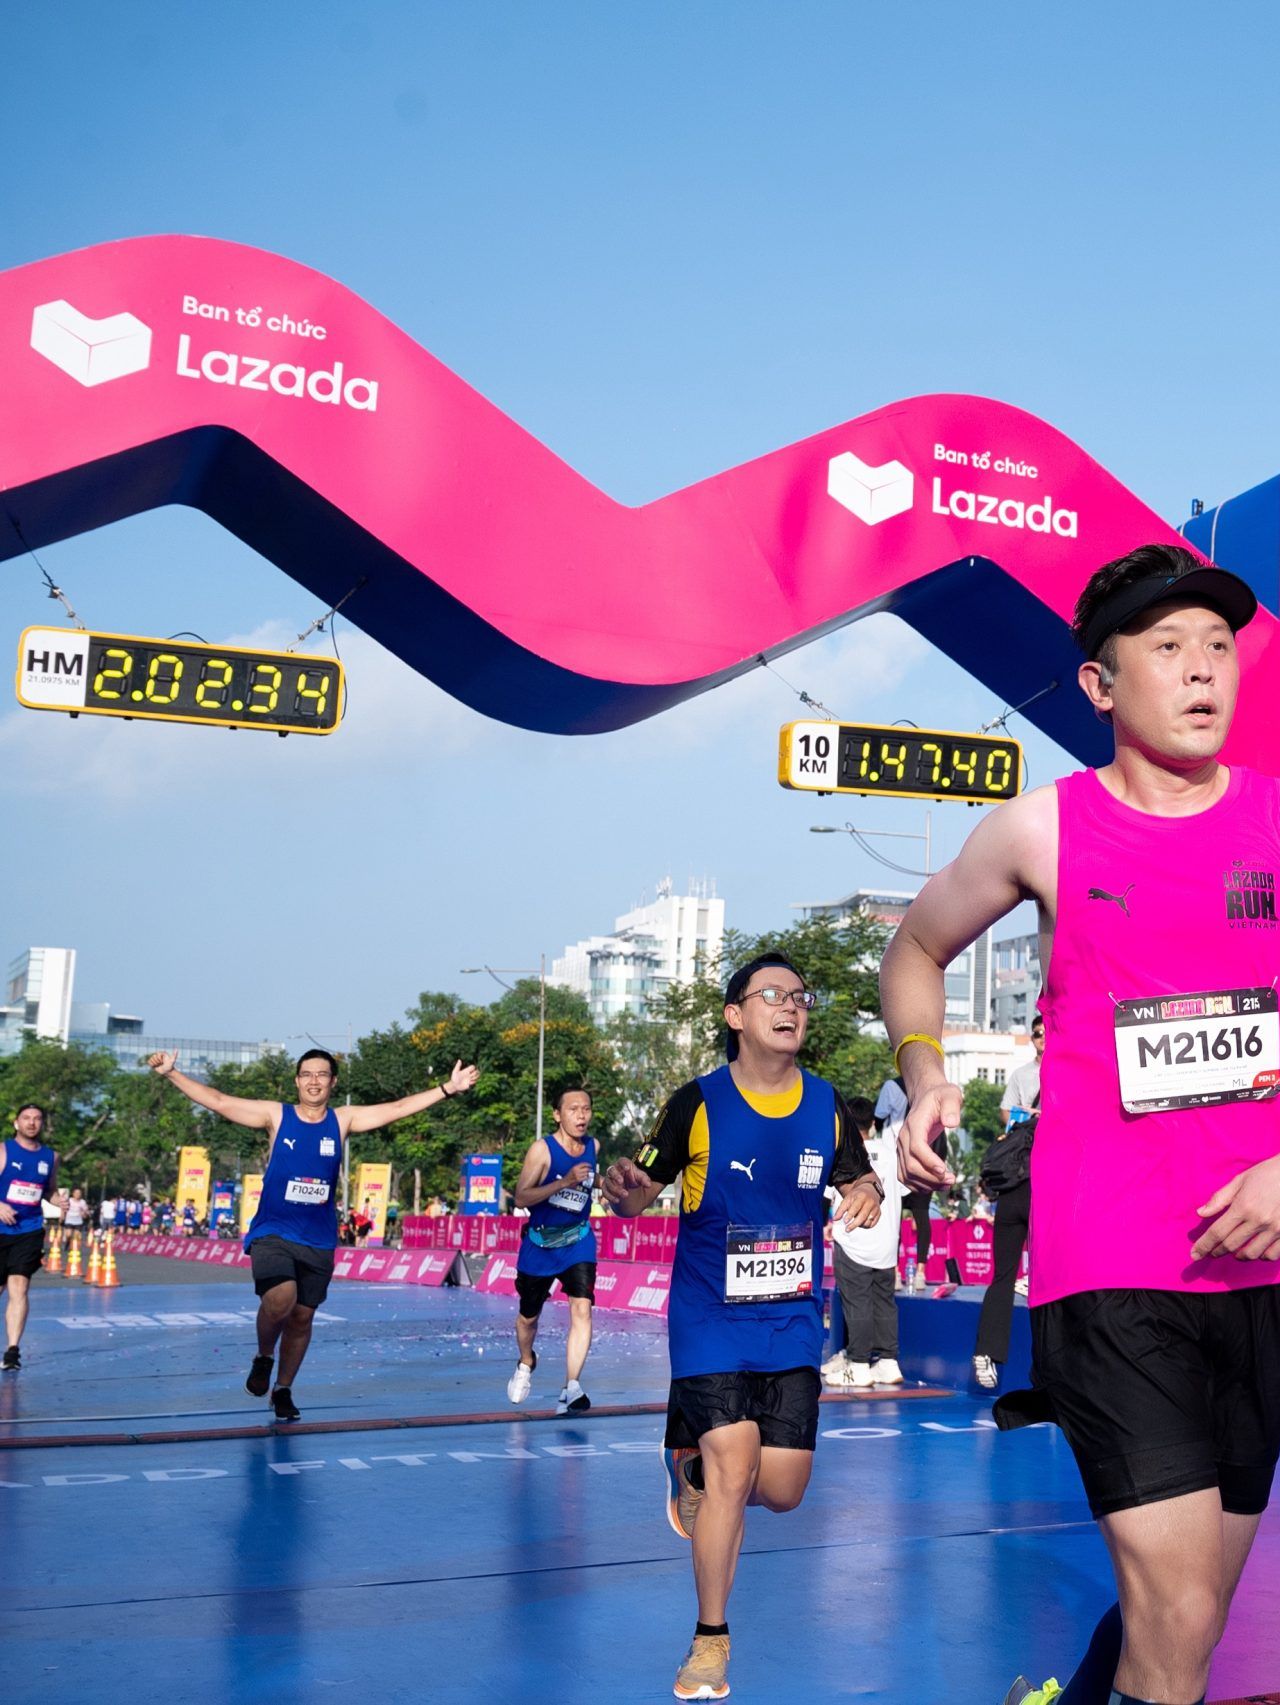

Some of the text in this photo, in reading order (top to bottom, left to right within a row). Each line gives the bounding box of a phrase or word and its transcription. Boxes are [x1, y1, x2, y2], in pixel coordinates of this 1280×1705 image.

[182, 295, 328, 341] Ban tổ chức
[176, 333, 380, 412] Lazada
[934, 443, 1039, 479] Ban tổ chức
[932, 476, 1079, 538] Lazada
[27, 649, 84, 677] HM
[27, 674, 81, 687] 21.0975 KM
[798, 734, 830, 759] 10
[799, 758, 827, 774] KM
[1223, 870, 1275, 890] LAZADA
[1226, 889, 1279, 921] RUN
[1229, 920, 1277, 929] VIETNAM
[1133, 1007, 1154, 1020] VN
[1137, 1025, 1263, 1068] M21616
[291, 1184, 326, 1197] F10240
[738, 1244, 751, 1252] VN
[736, 1256, 805, 1278] M21396
[0, 1468, 230, 1487] DD
